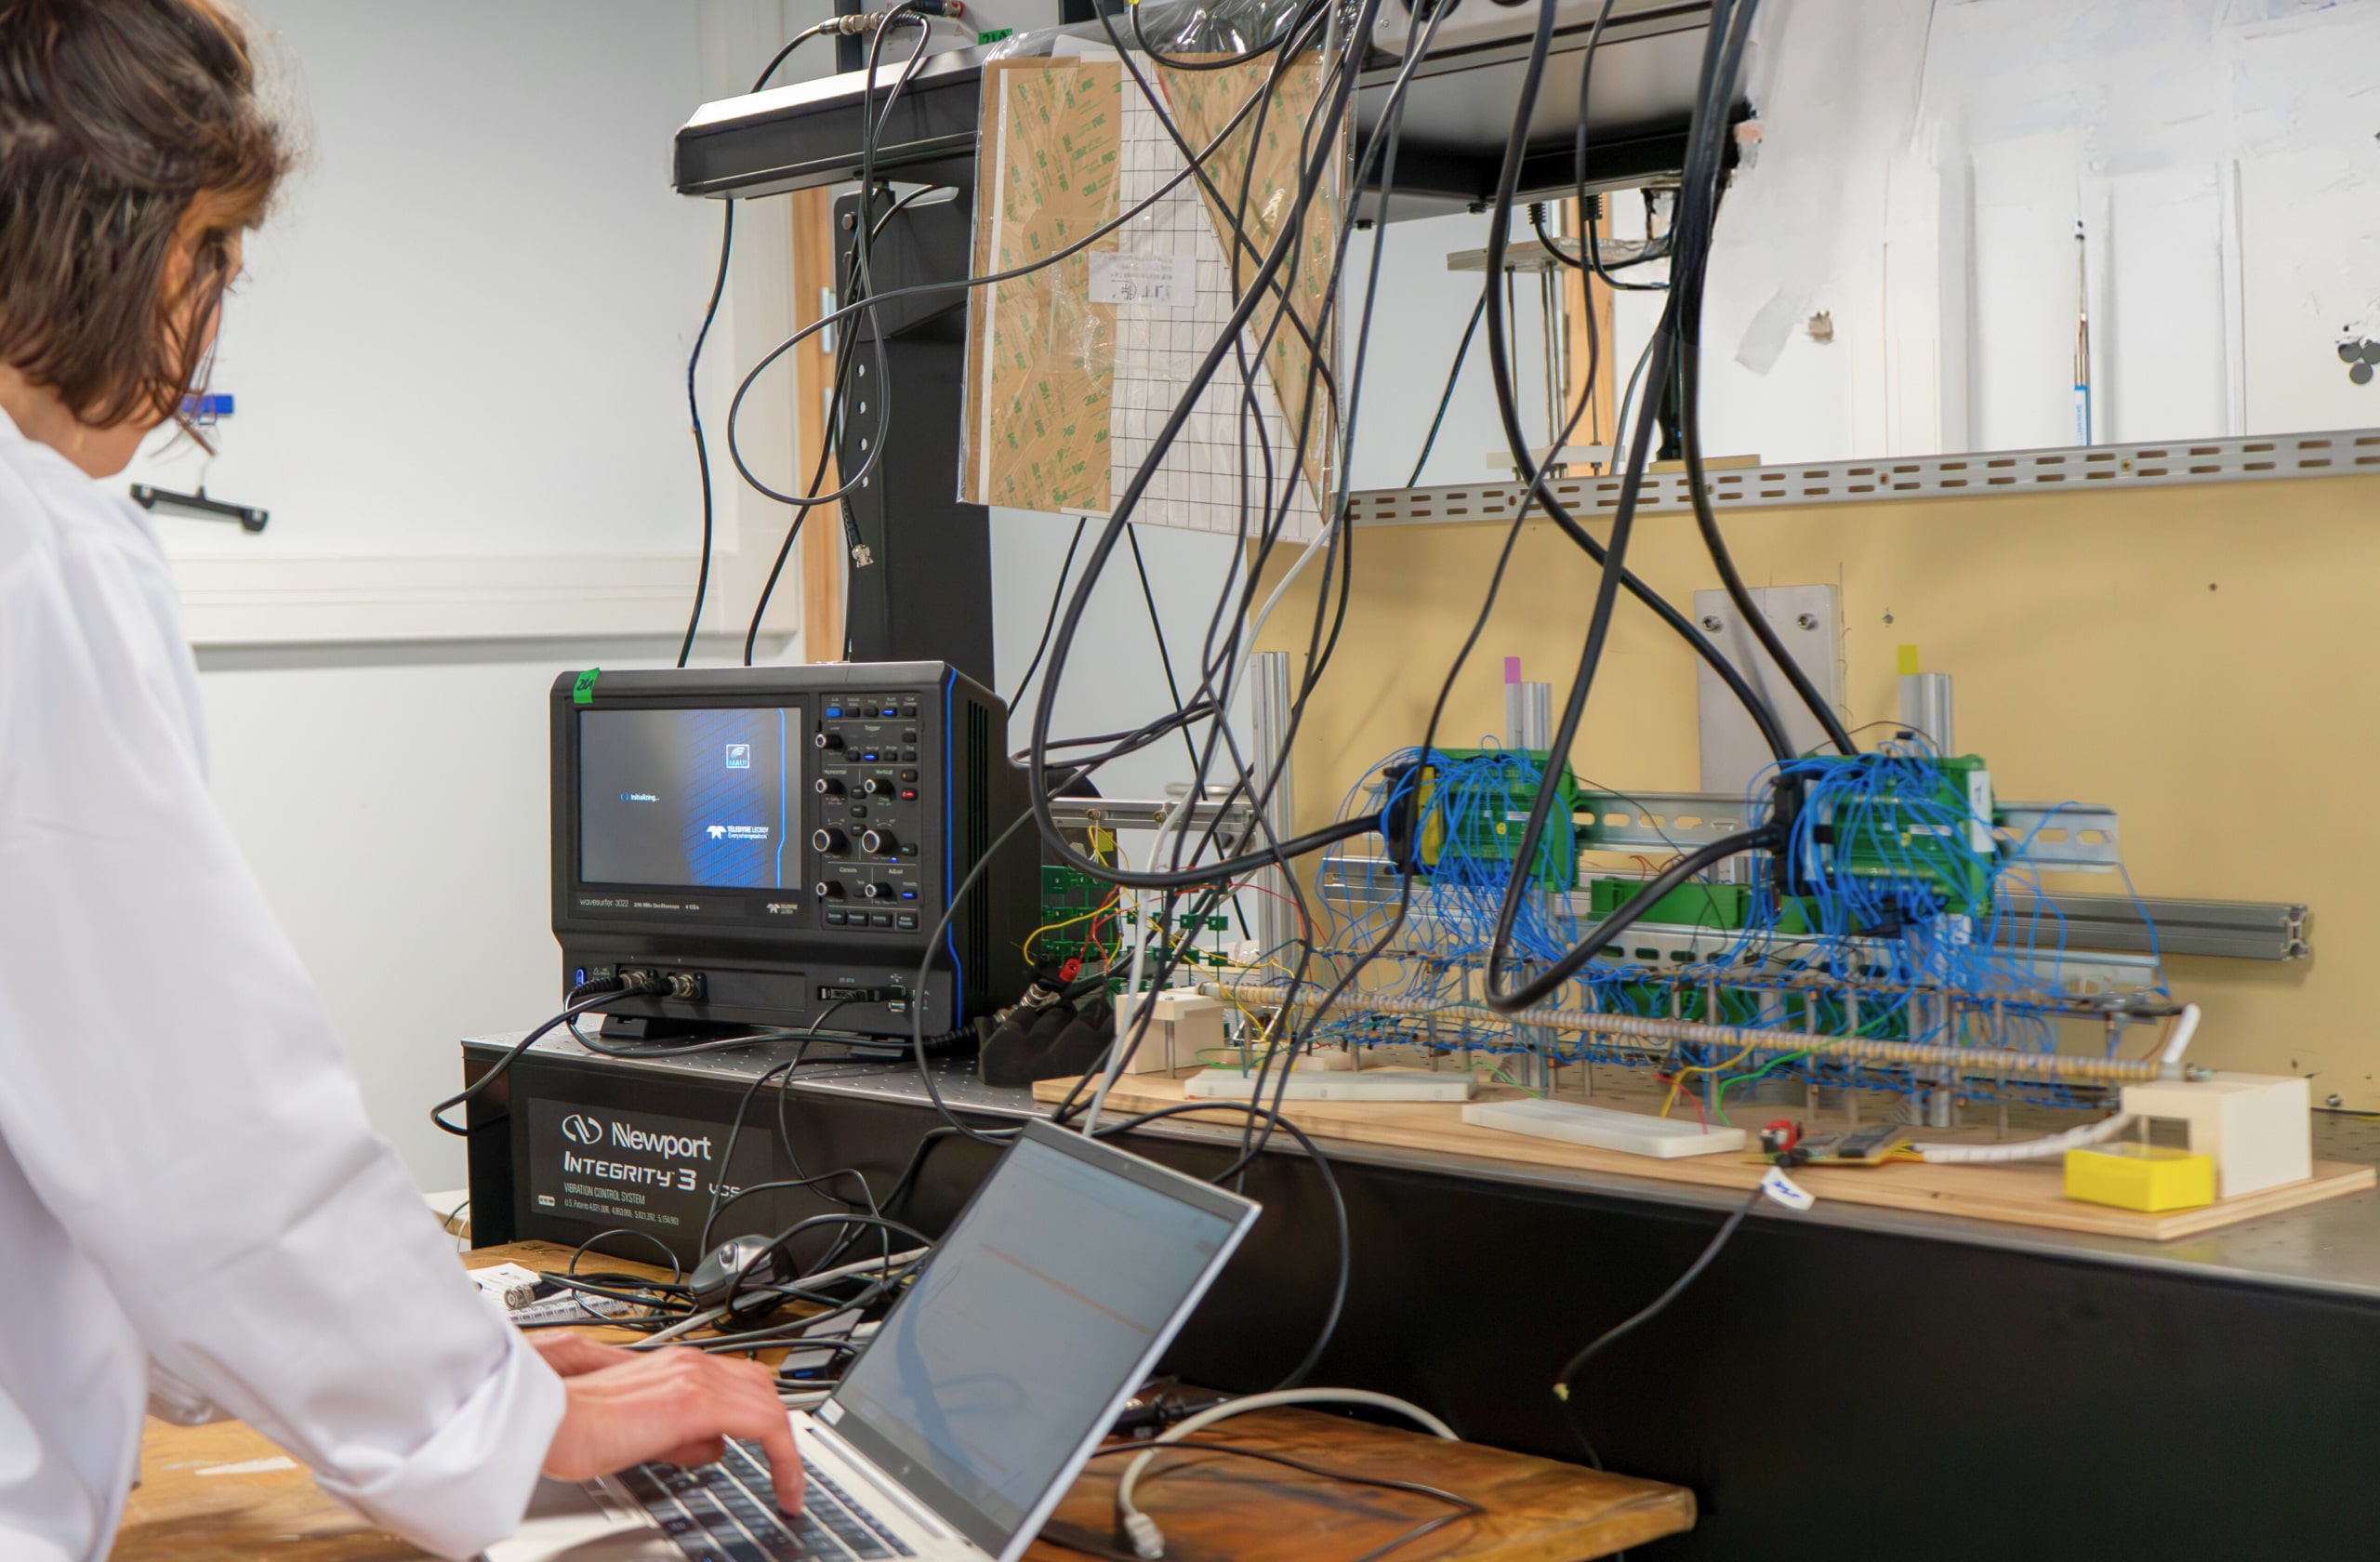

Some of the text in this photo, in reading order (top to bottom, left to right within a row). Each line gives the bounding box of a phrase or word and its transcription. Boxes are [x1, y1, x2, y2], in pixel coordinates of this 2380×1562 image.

[579, 898, 613, 907] wavesurfer
[612, 1121, 712, 1160] Newport
[677, 1168, 697, 1191] 3
[563, 1182, 646, 1206] VIBRATION CONTROL SYSTEM
